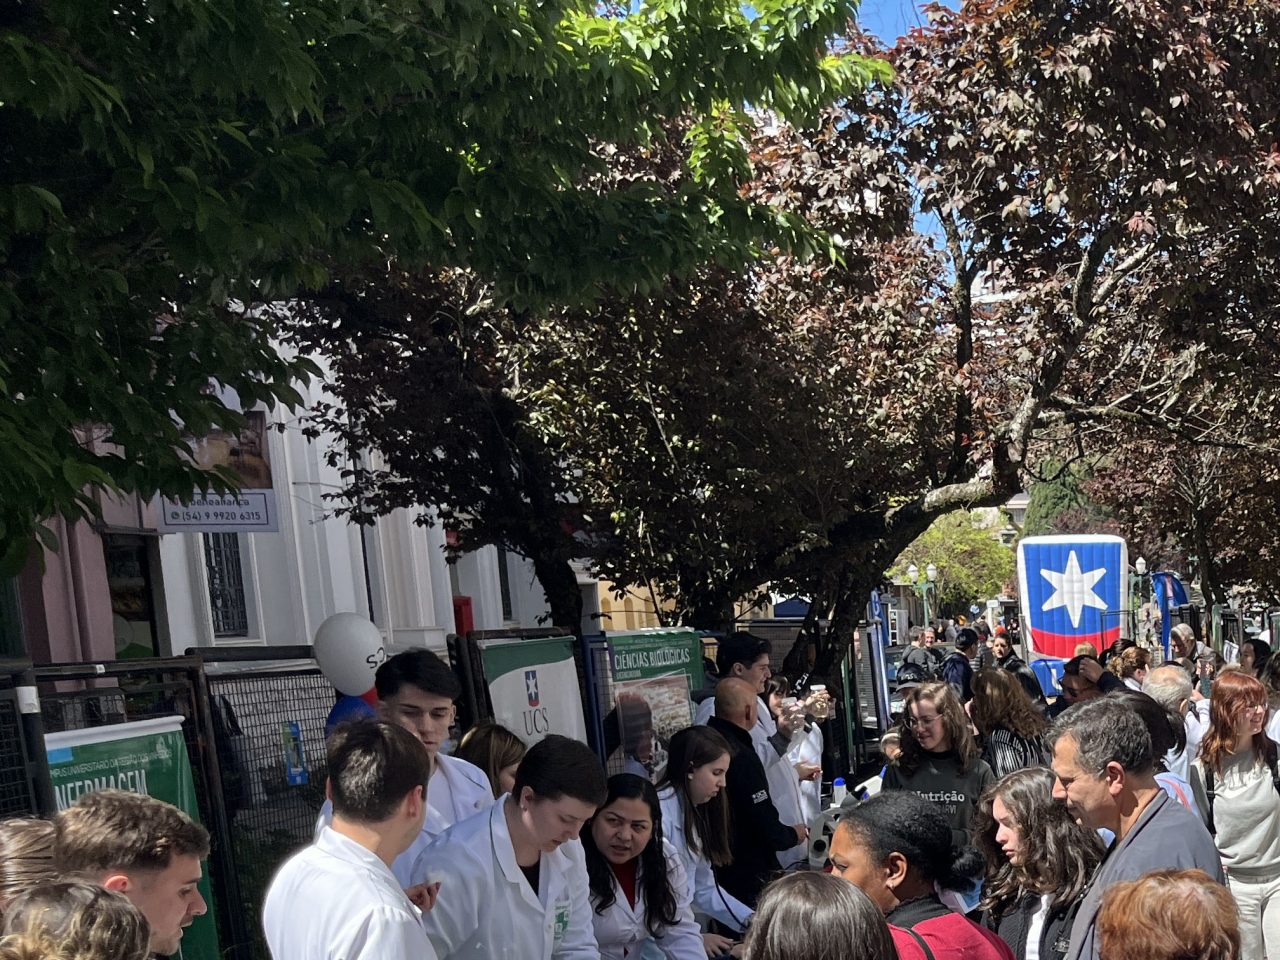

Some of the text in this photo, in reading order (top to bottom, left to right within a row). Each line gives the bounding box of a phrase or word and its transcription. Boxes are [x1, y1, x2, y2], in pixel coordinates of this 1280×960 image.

[183, 511, 202, 521] (54)
[205, 512, 210, 520] 9
[615, 650, 649, 670] CIÊNCIAS
[523, 708, 549, 735] UCS
